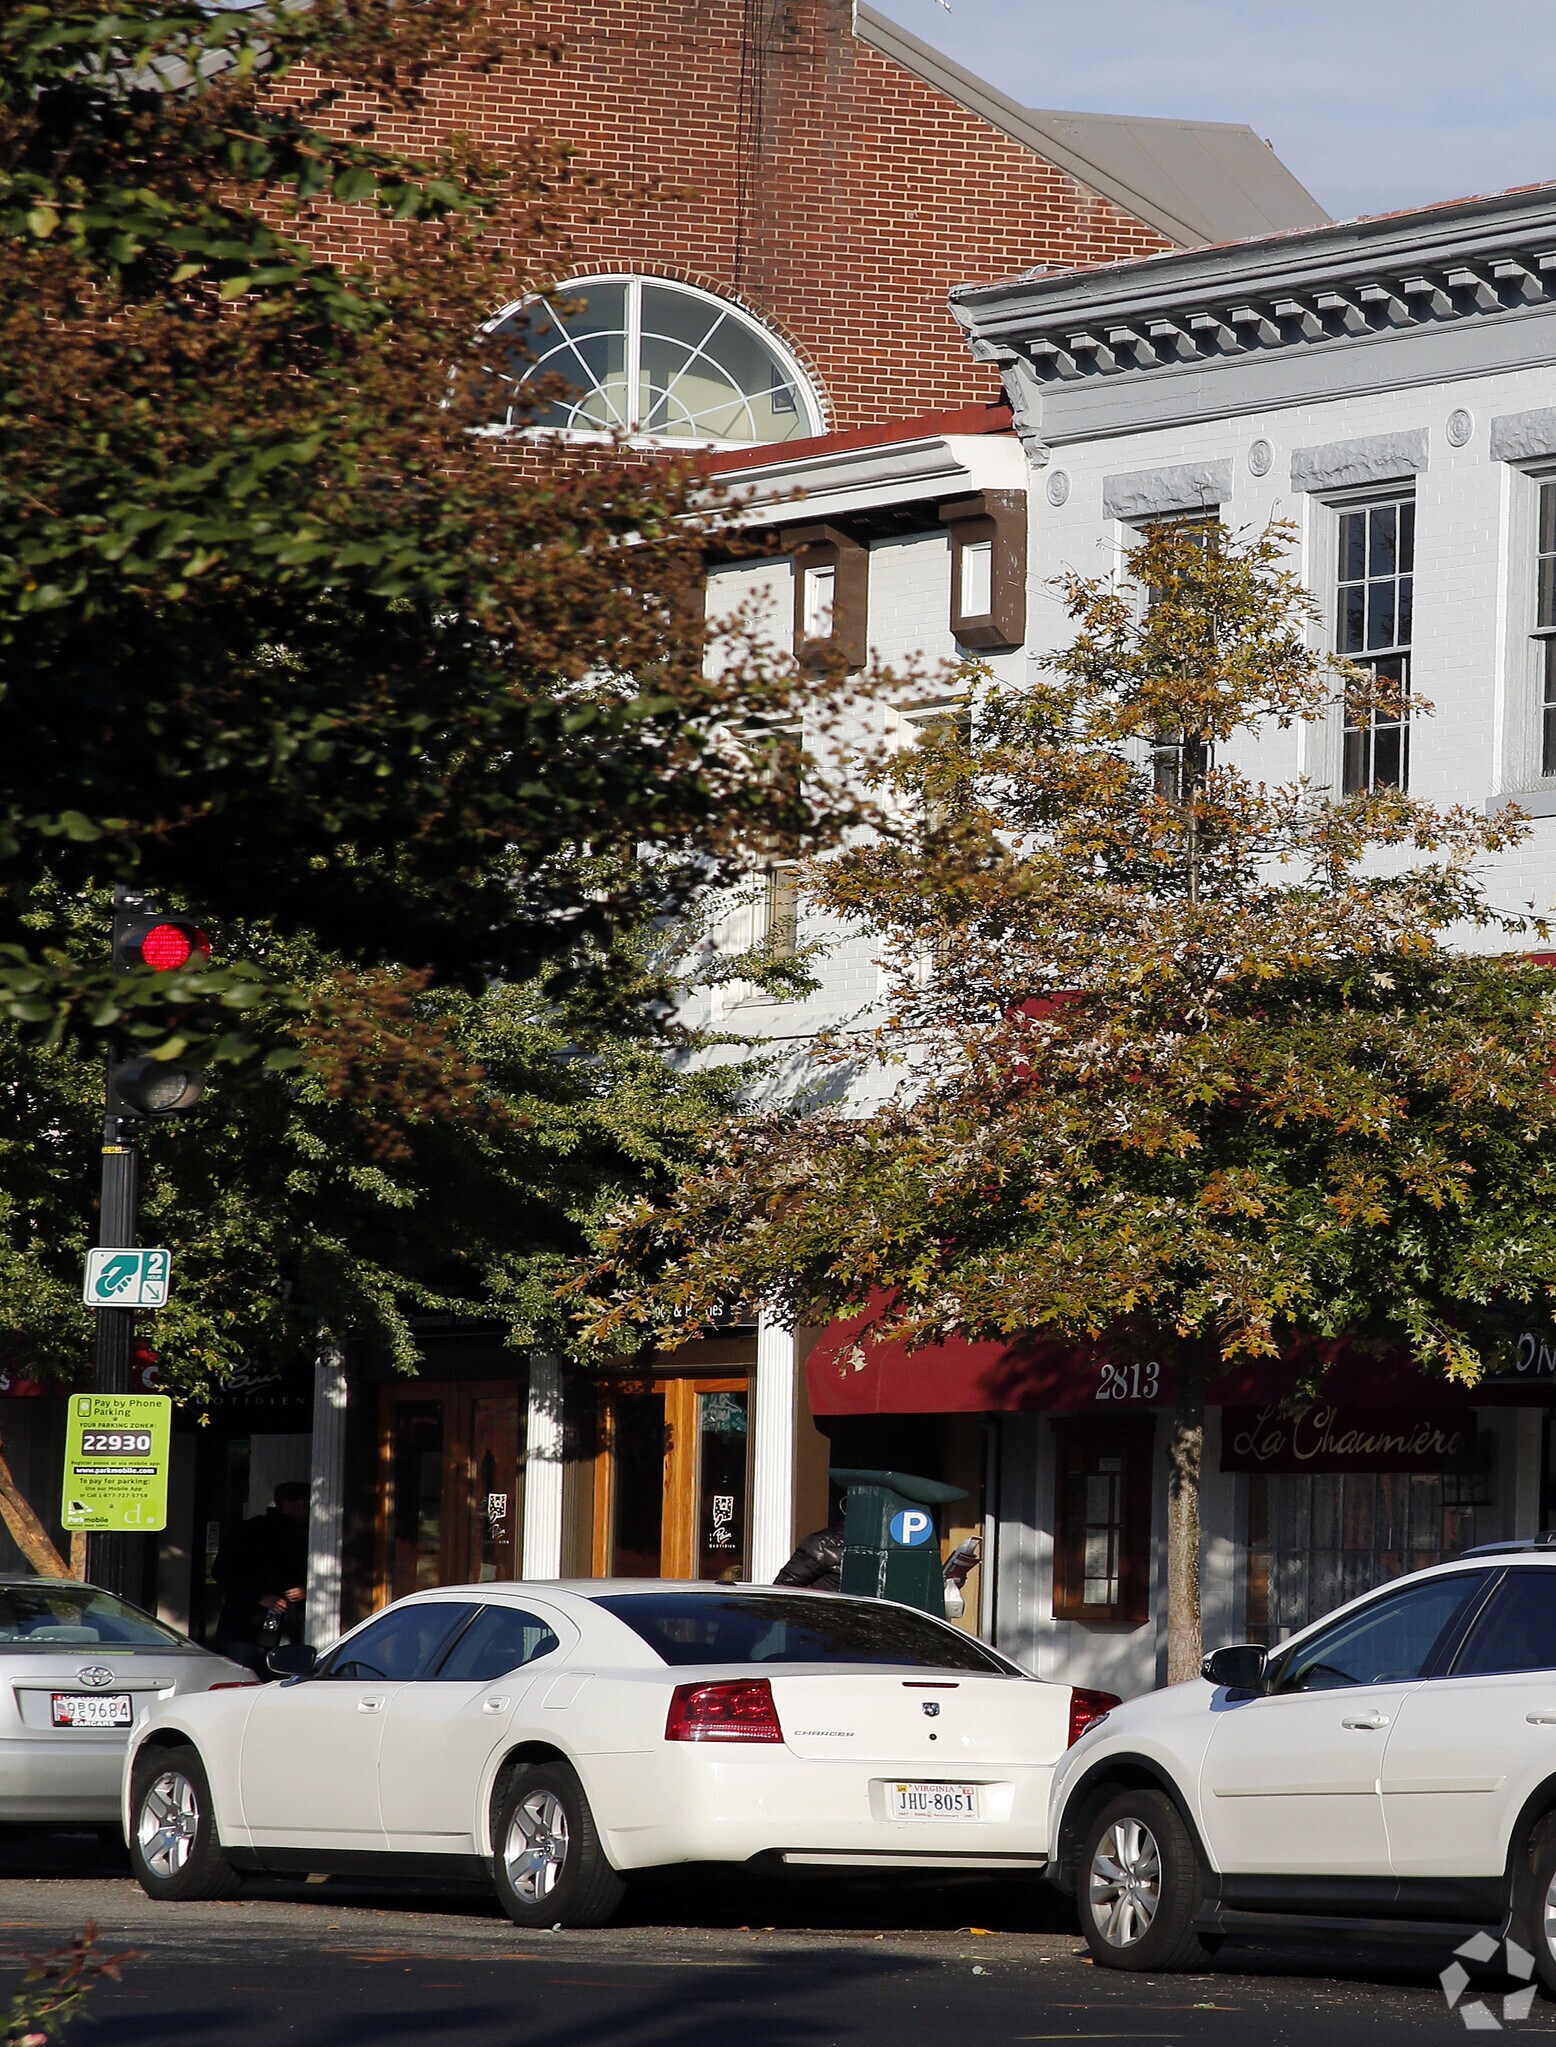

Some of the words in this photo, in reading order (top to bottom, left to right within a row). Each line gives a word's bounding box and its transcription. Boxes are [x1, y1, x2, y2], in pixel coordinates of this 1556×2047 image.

[147, 1253, 163, 1274] 2
[1095, 1361, 1160, 1400] 2813
[94, 1399, 110, 1408] Pay
[114, 1400, 125, 1408] by
[129, 1400, 162, 1408] Phone
[94, 1408, 131, 1417] Parking
[1233, 1405, 1287, 1460] La
[83, 1435, 150, 1451] 22930
[902, 1511, 928, 1544] P
[914, 1784, 955, 1793] VIRGINIA
[900, 1792, 973, 1811] JHU-8051
